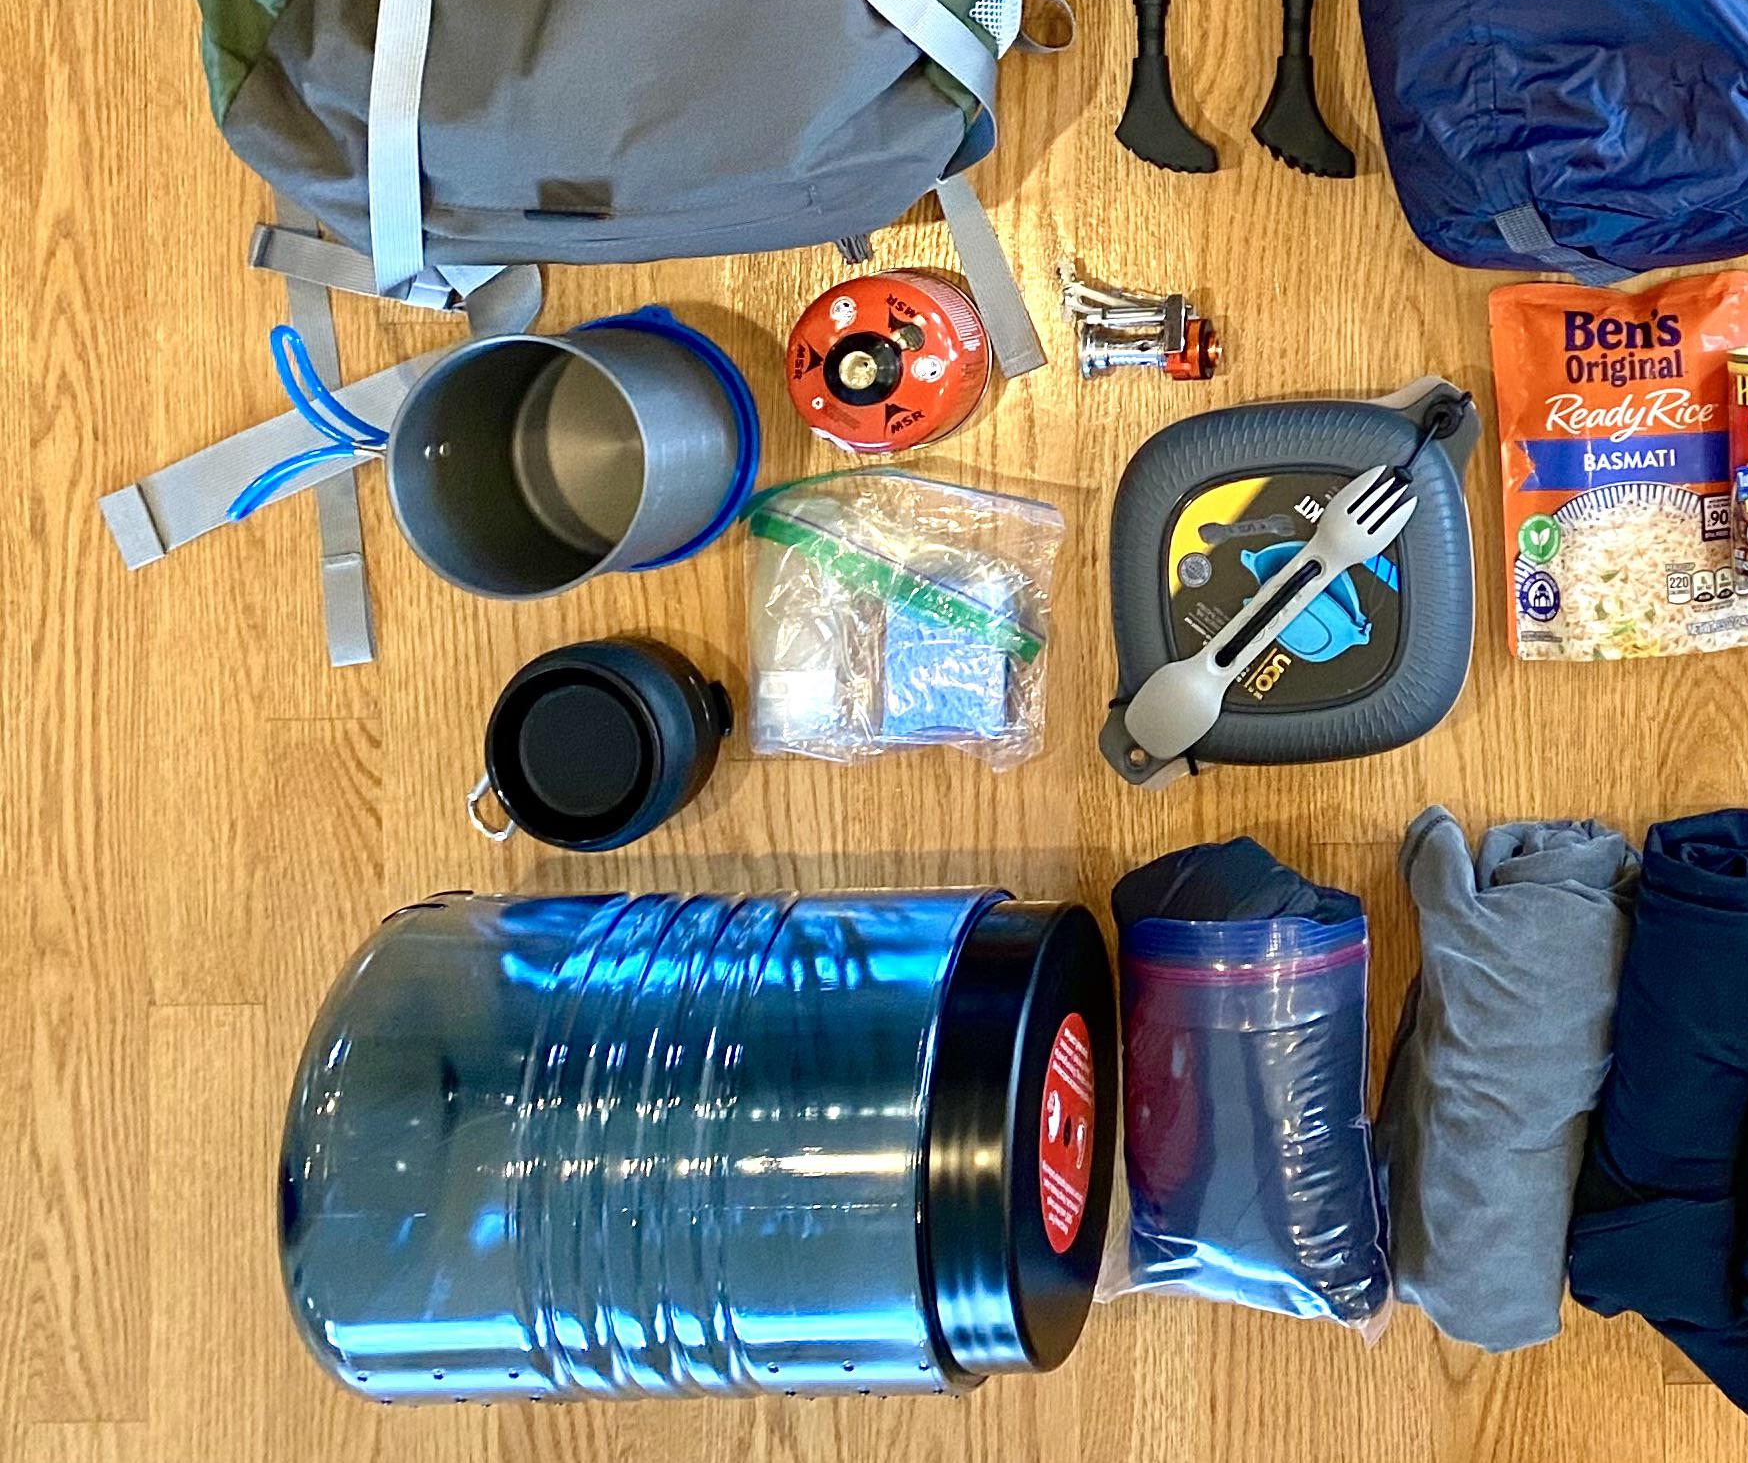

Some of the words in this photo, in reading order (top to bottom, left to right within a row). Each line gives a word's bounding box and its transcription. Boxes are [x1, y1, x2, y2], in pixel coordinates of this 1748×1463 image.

[886, 293, 918, 319] MSR
[1564, 308, 1682, 351] Ben's
[793, 343, 806, 381] MSR
[1566, 349, 1684, 387] Original
[891, 409, 926, 434] MSR
[1545, 394, 1649, 443] Ready
[1645, 388, 1714, 429] Rice
[1584, 449, 1676, 472] BASMATI
[1294, 495, 1325, 523] KIT
[1669, 576, 1689, 589] 220
